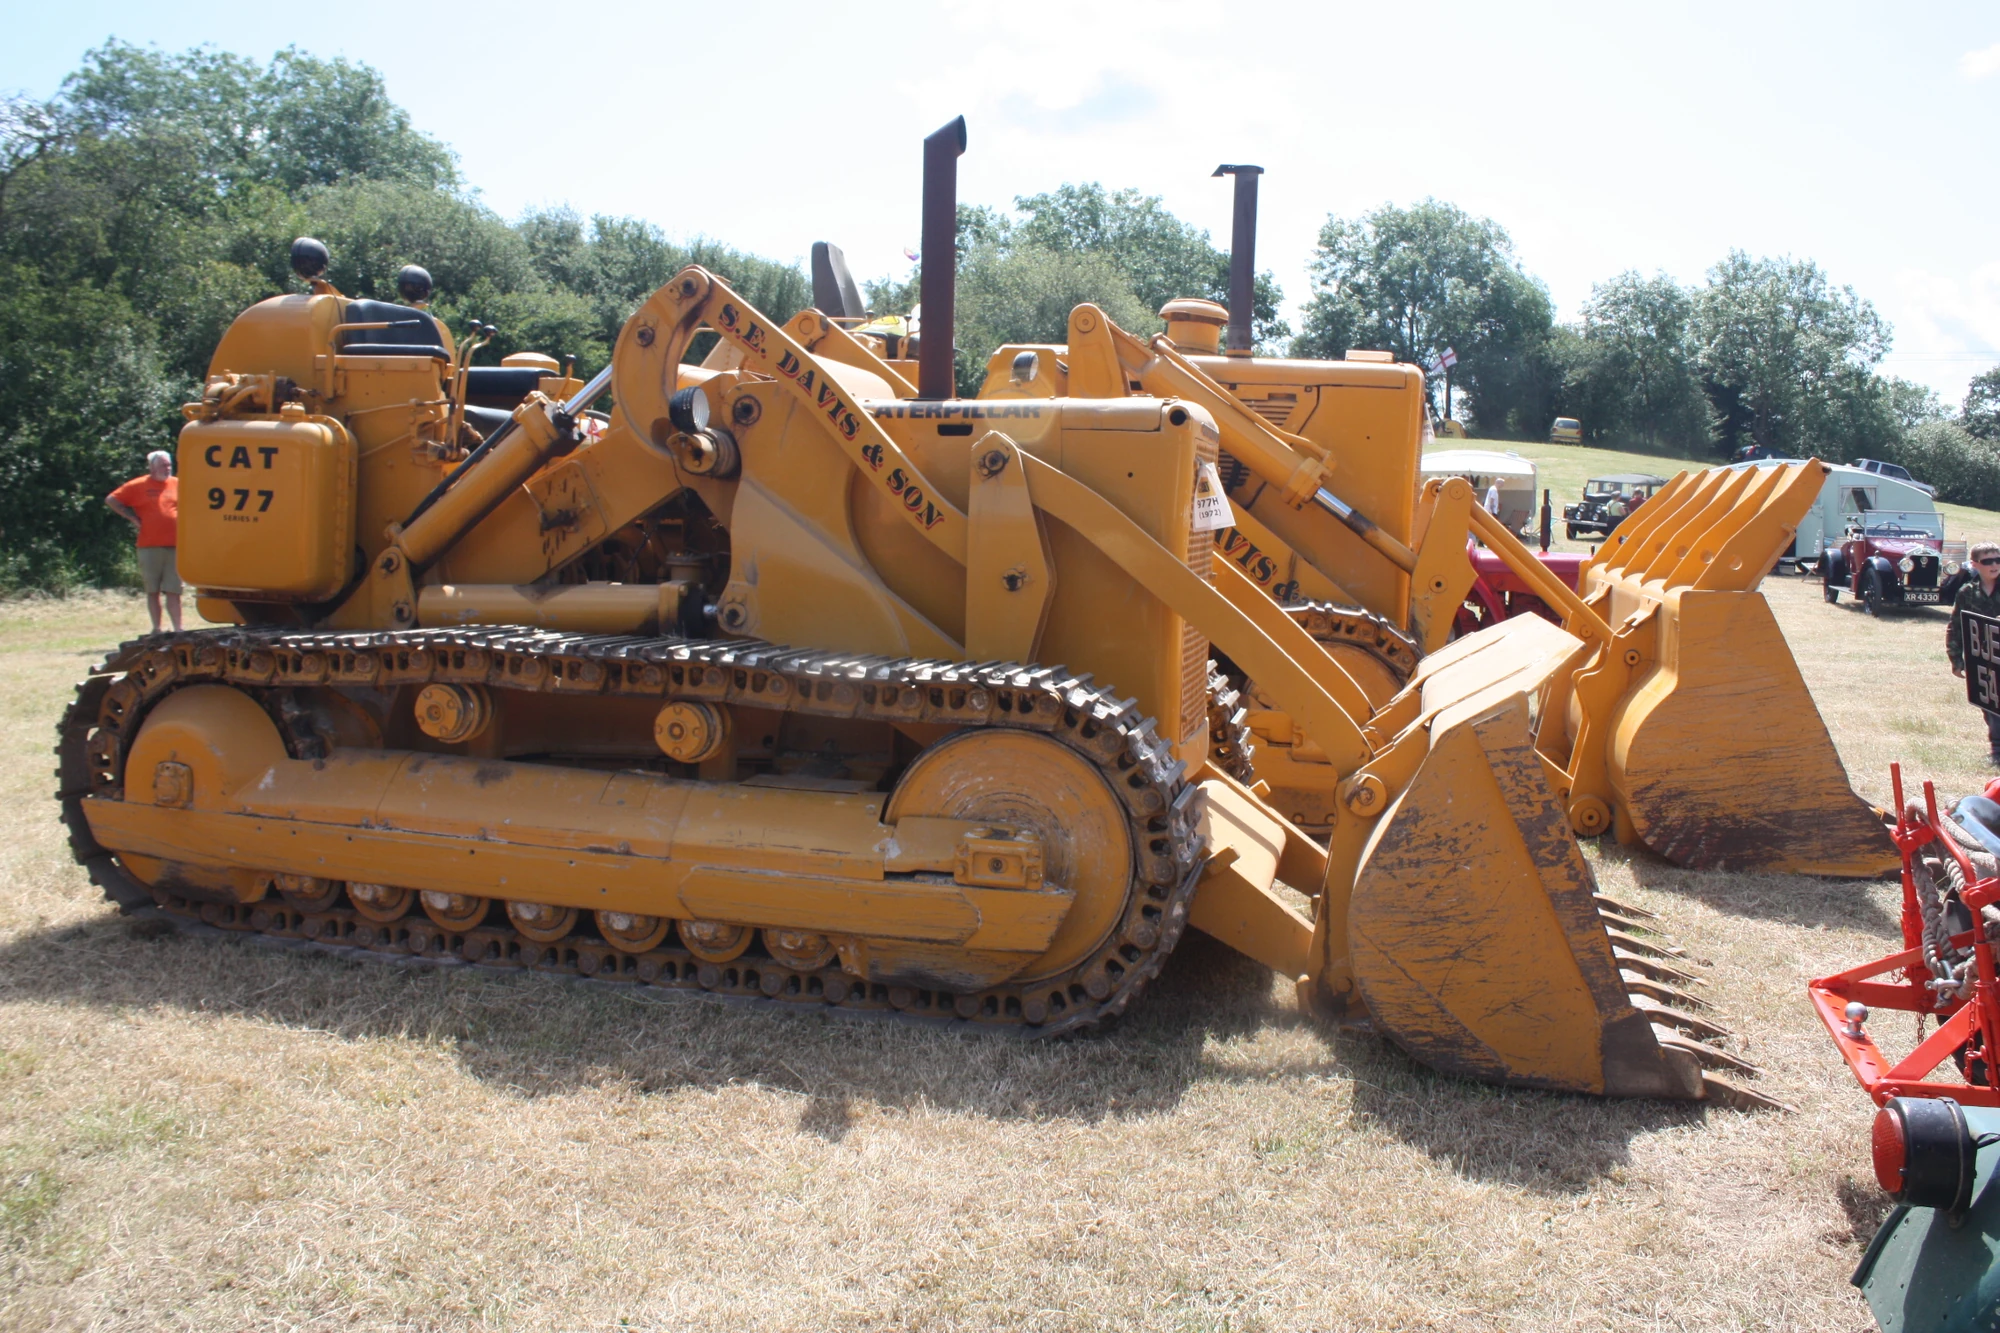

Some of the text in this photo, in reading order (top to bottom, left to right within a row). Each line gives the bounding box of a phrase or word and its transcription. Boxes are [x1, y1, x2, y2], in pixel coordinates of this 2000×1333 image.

[718, 303, 945, 531] S.E. DAVIS & SON
[874, 404, 1040, 419] ATERPILLAR
[204, 445, 279, 469] CAT
[207, 487, 274, 512] 977
[1197, 497, 1219, 508] 977H
[223, 514, 250, 522] SERIES
[1199, 509, 1222, 520] (1972)
[1213, 527, 1278, 586] VIS
[1905, 593, 1917, 601] XR
[1968, 618, 2000, 665] BJE
